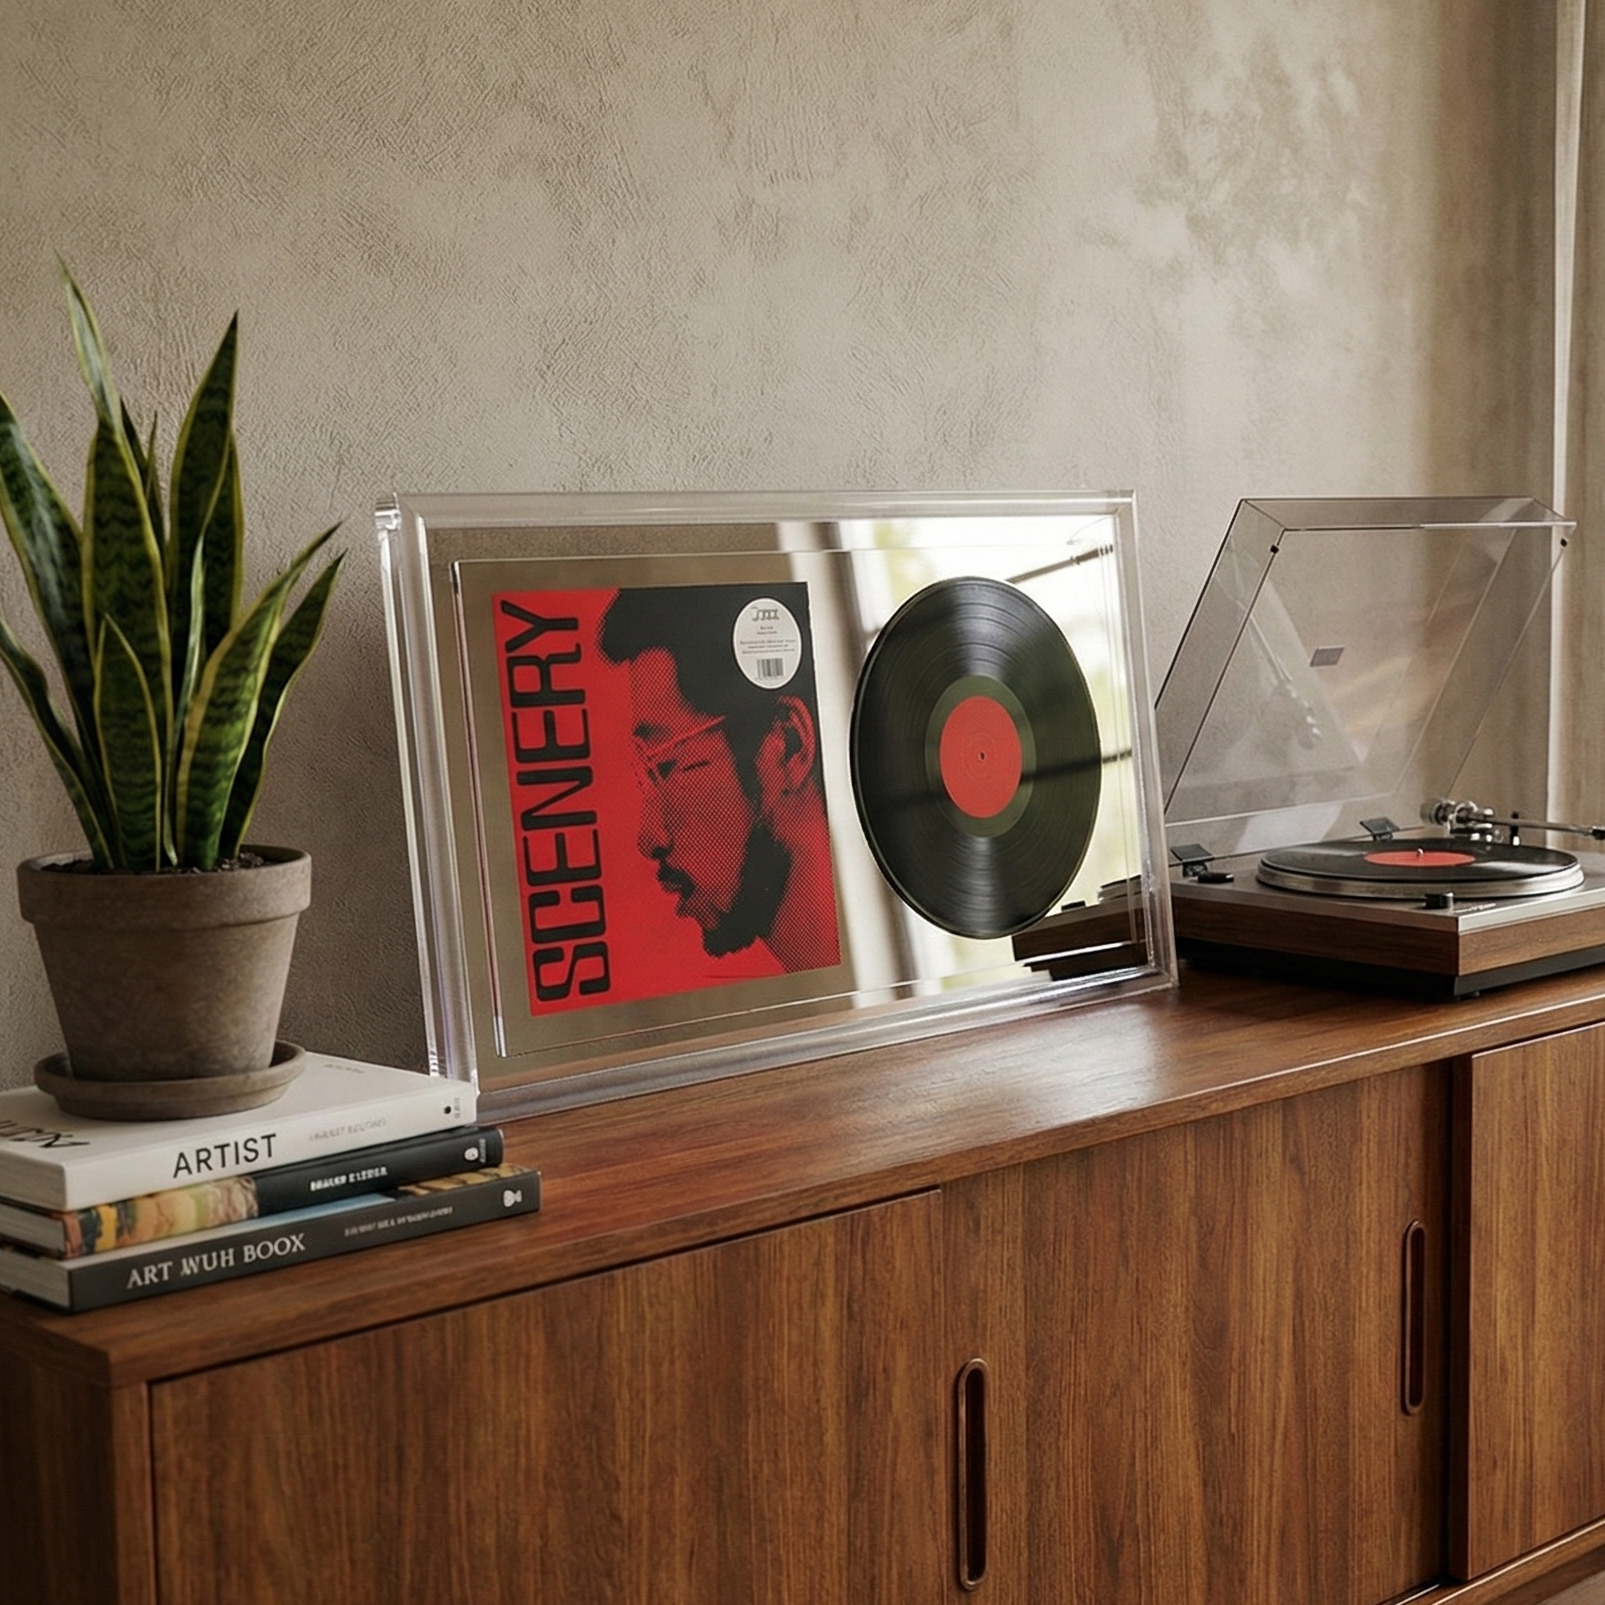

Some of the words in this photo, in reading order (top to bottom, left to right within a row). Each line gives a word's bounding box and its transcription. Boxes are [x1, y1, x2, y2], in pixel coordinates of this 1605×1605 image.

[501, 599, 611, 1002] SCENERY
[173, 1133, 277, 1179] ARTIST
[126, 1260, 173, 1290] ART
[242, 1232, 306, 1264] BOOX
